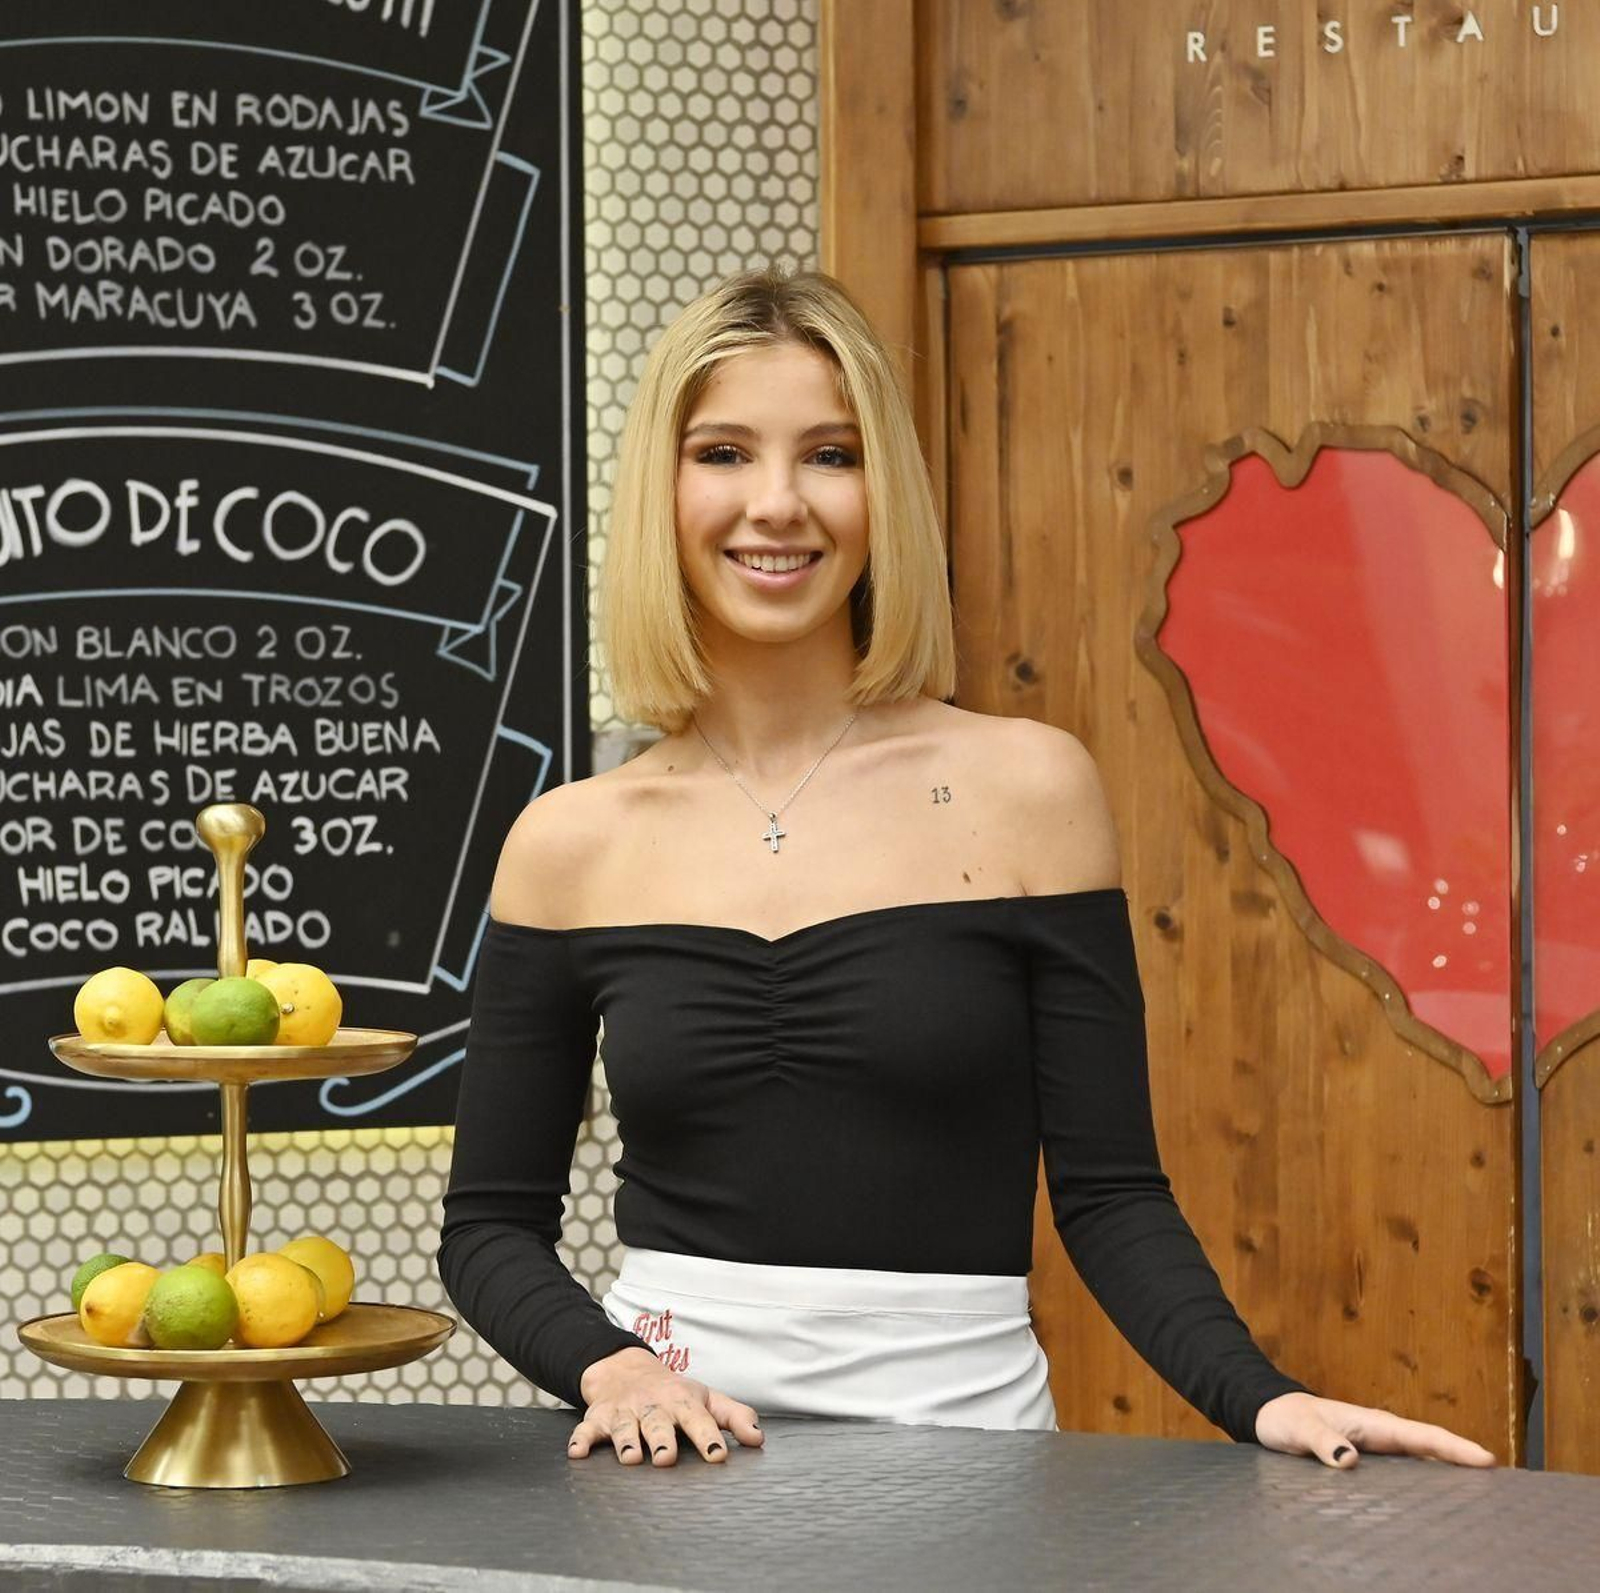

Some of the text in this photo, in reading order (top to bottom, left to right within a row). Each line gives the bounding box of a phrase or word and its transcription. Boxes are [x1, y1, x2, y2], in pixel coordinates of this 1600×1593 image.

[1186, 5, 1559, 63] RESTAU
[27, 88, 410, 138] LIMON EN RODAJAS
[190, 141, 239, 179] DE
[258, 145, 415, 185] AZUCAR
[13, 183, 286, 227] HIELO PICADO
[46, 235, 216, 274] DORADO
[250, 237, 279, 278] 2
[294, 242, 363, 281] OZ.
[35, 280, 257, 331] MARACUYA
[292, 291, 317, 330] 3
[330, 291, 396, 329] OZ.
[125, 478, 201, 557] DE
[212, 486, 427, 587] COCO
[75, 625, 237, 660] BLANCO
[257, 624, 277, 659] 2
[295, 624, 363, 660] OZ.
[0, 672, 399, 709] IA LIMA EN TROZOS
[0, 715, 441, 758] JAS DE HIERBA BUENA
[0, 763, 410, 806] CHARAS DE AZUCAR
[931, 785, 952, 804] 13
[71, 816, 128, 856] DE
[17, 861, 131, 906] HIELO
[2, 916, 119, 957] COCO
